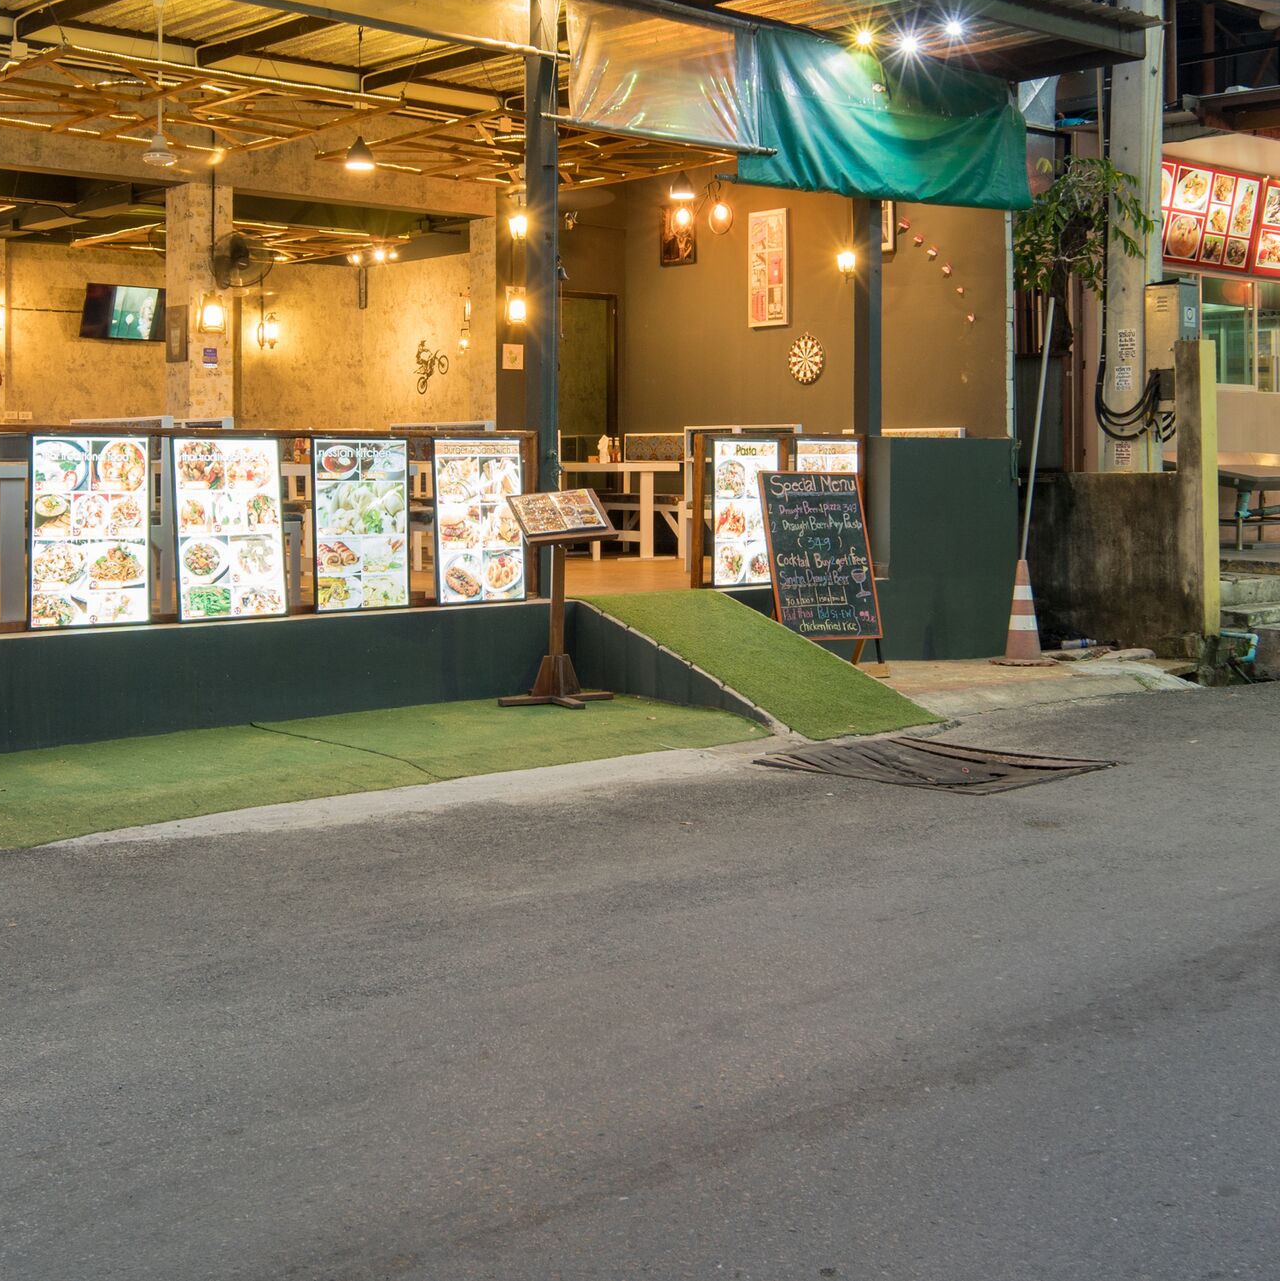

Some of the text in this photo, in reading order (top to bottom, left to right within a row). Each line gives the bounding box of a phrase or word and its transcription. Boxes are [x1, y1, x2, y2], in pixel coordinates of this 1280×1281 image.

[355, 446, 391, 458] kitchen
[736, 444, 757, 456] Pasta
[818, 444, 836, 454] Pizza
[770, 475, 856, 502] Special Menu
[776, 551, 810, 568] Cocktail
[813, 552, 831, 572] Buy
